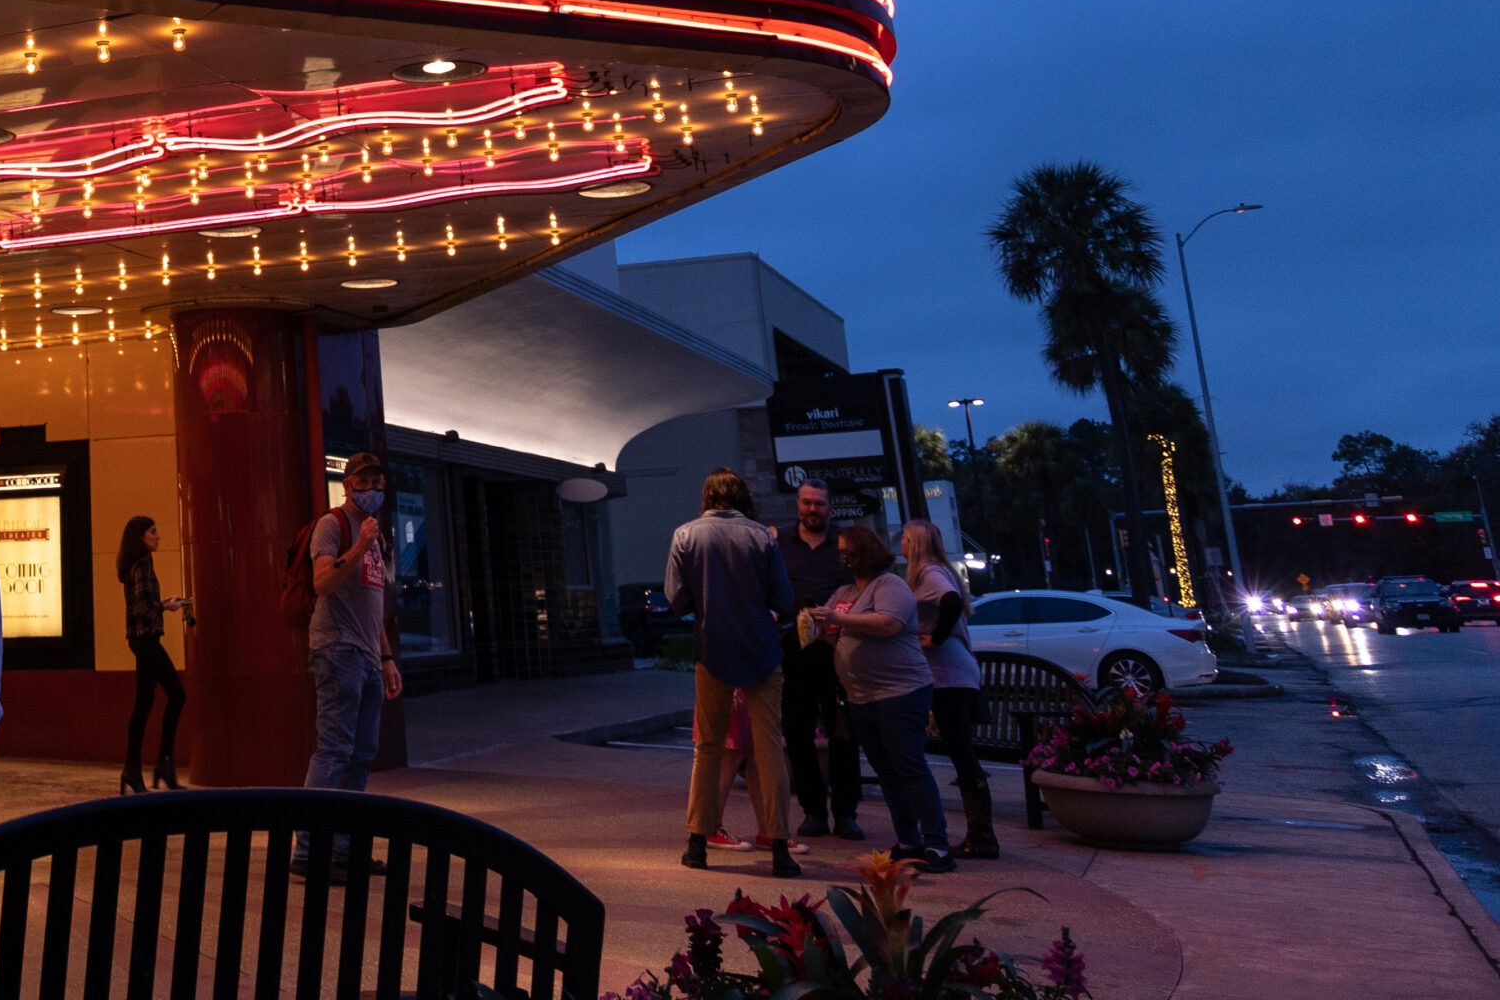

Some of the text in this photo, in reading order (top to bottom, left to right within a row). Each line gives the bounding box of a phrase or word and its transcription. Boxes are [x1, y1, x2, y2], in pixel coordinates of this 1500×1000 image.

[806, 408, 839, 420] vikari
[810, 466, 882, 479] BEAUTIFULLY
[830, 507, 864, 517] OPPING
[3, 579, 45, 595] SOON
